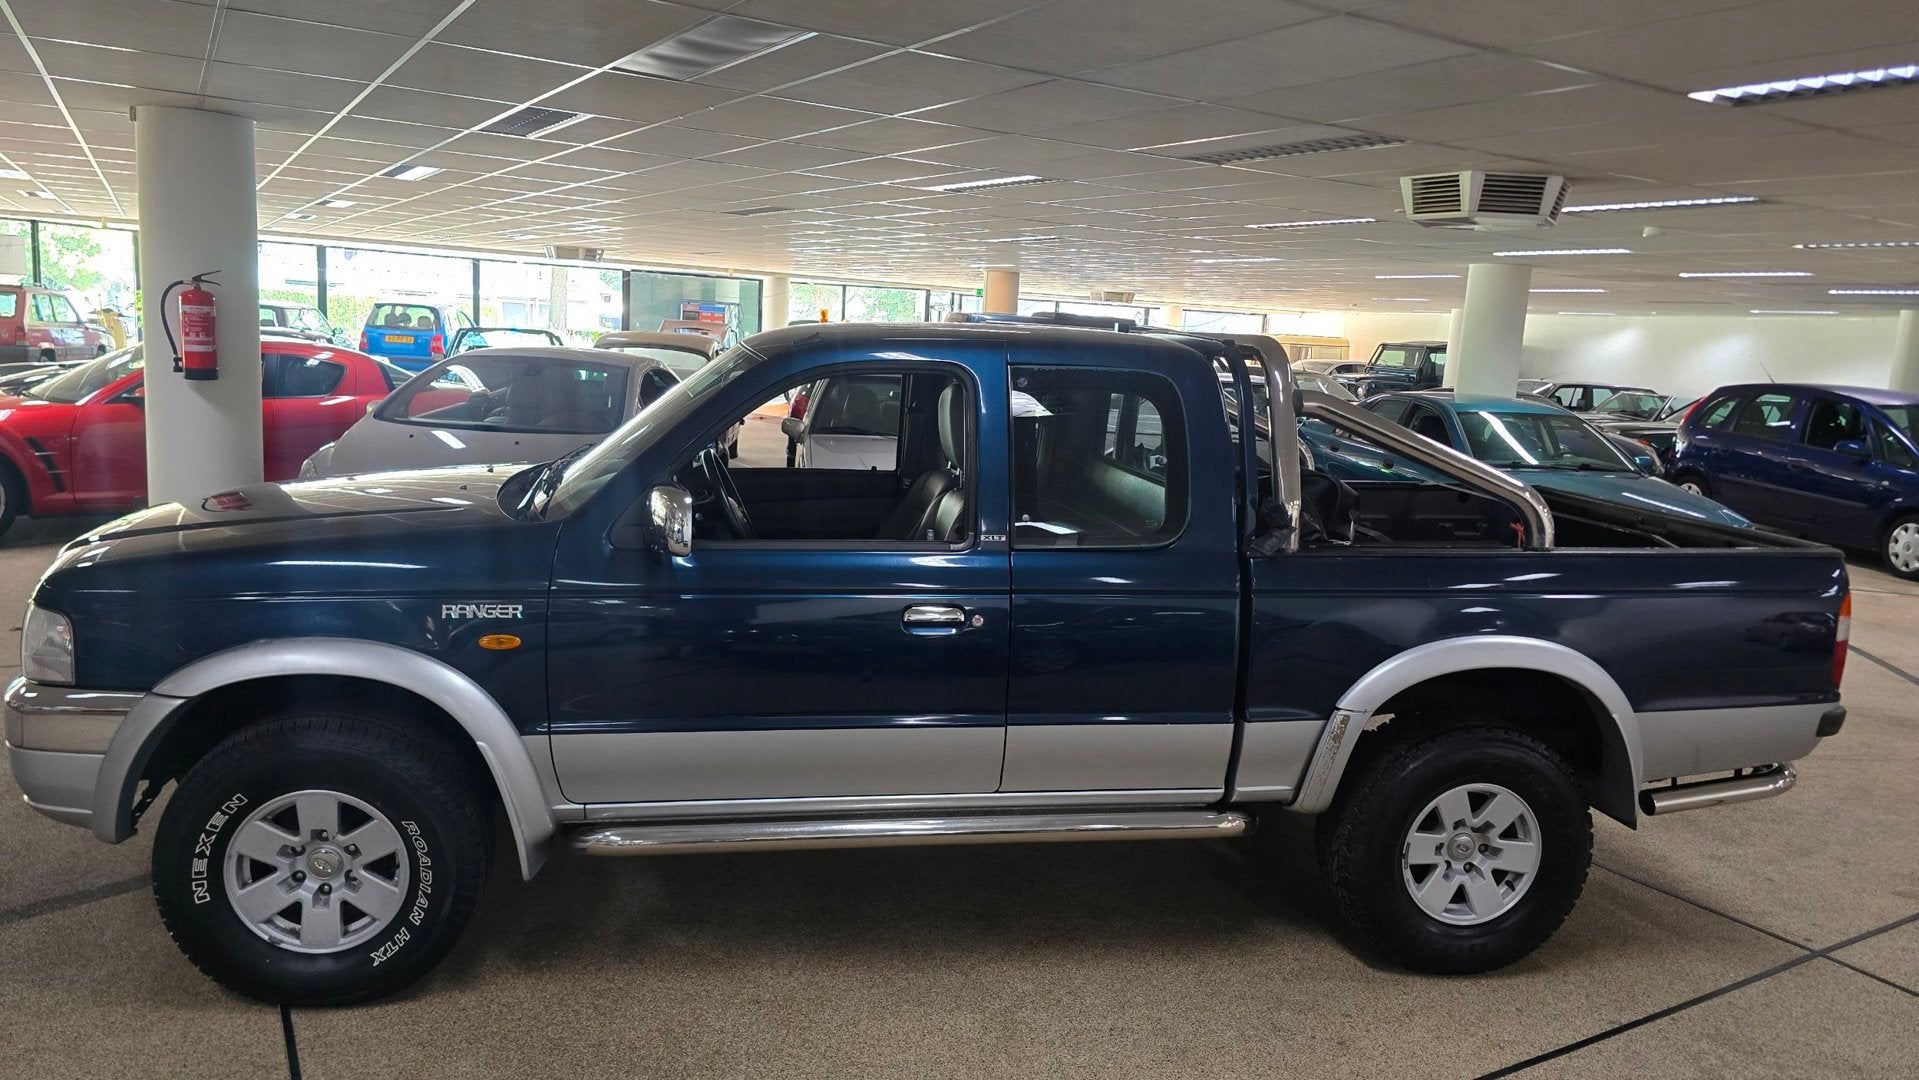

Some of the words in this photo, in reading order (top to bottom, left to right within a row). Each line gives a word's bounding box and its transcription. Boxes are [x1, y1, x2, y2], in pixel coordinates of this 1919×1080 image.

[441, 604, 523, 619] RANGER
[192, 793, 249, 904] NEXEN
[401, 820, 433, 926] ROADIAN
[370, 926, 411, 967] HTX
